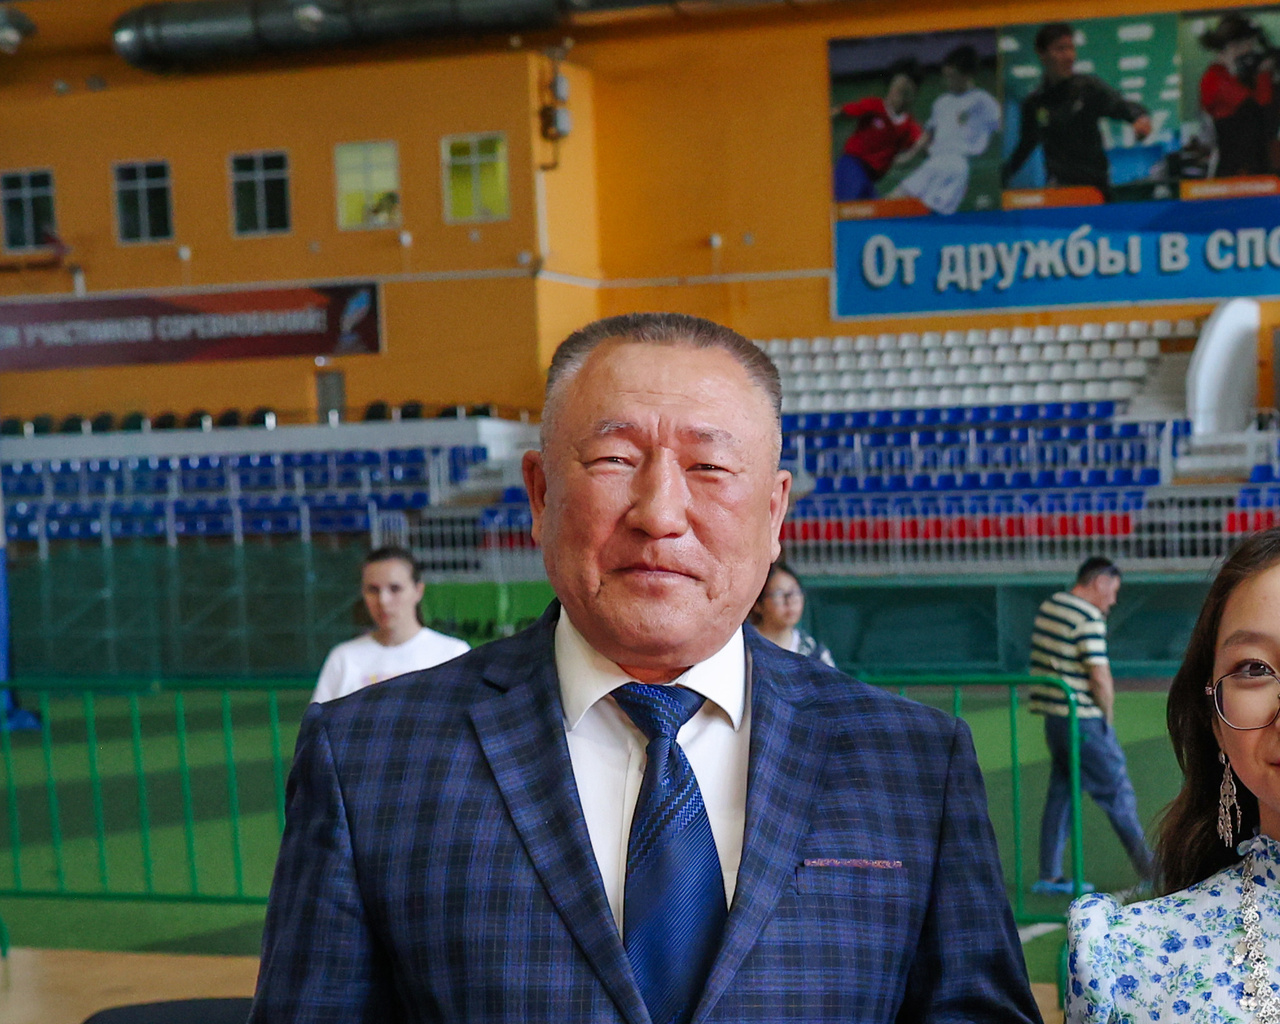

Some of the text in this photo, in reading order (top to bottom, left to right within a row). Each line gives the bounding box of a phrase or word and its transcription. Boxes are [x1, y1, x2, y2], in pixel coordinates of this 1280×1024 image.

[862, 234, 921, 287] От
[936, 225, 1142, 292] дружбы
[1160, 232, 1189, 272] в
